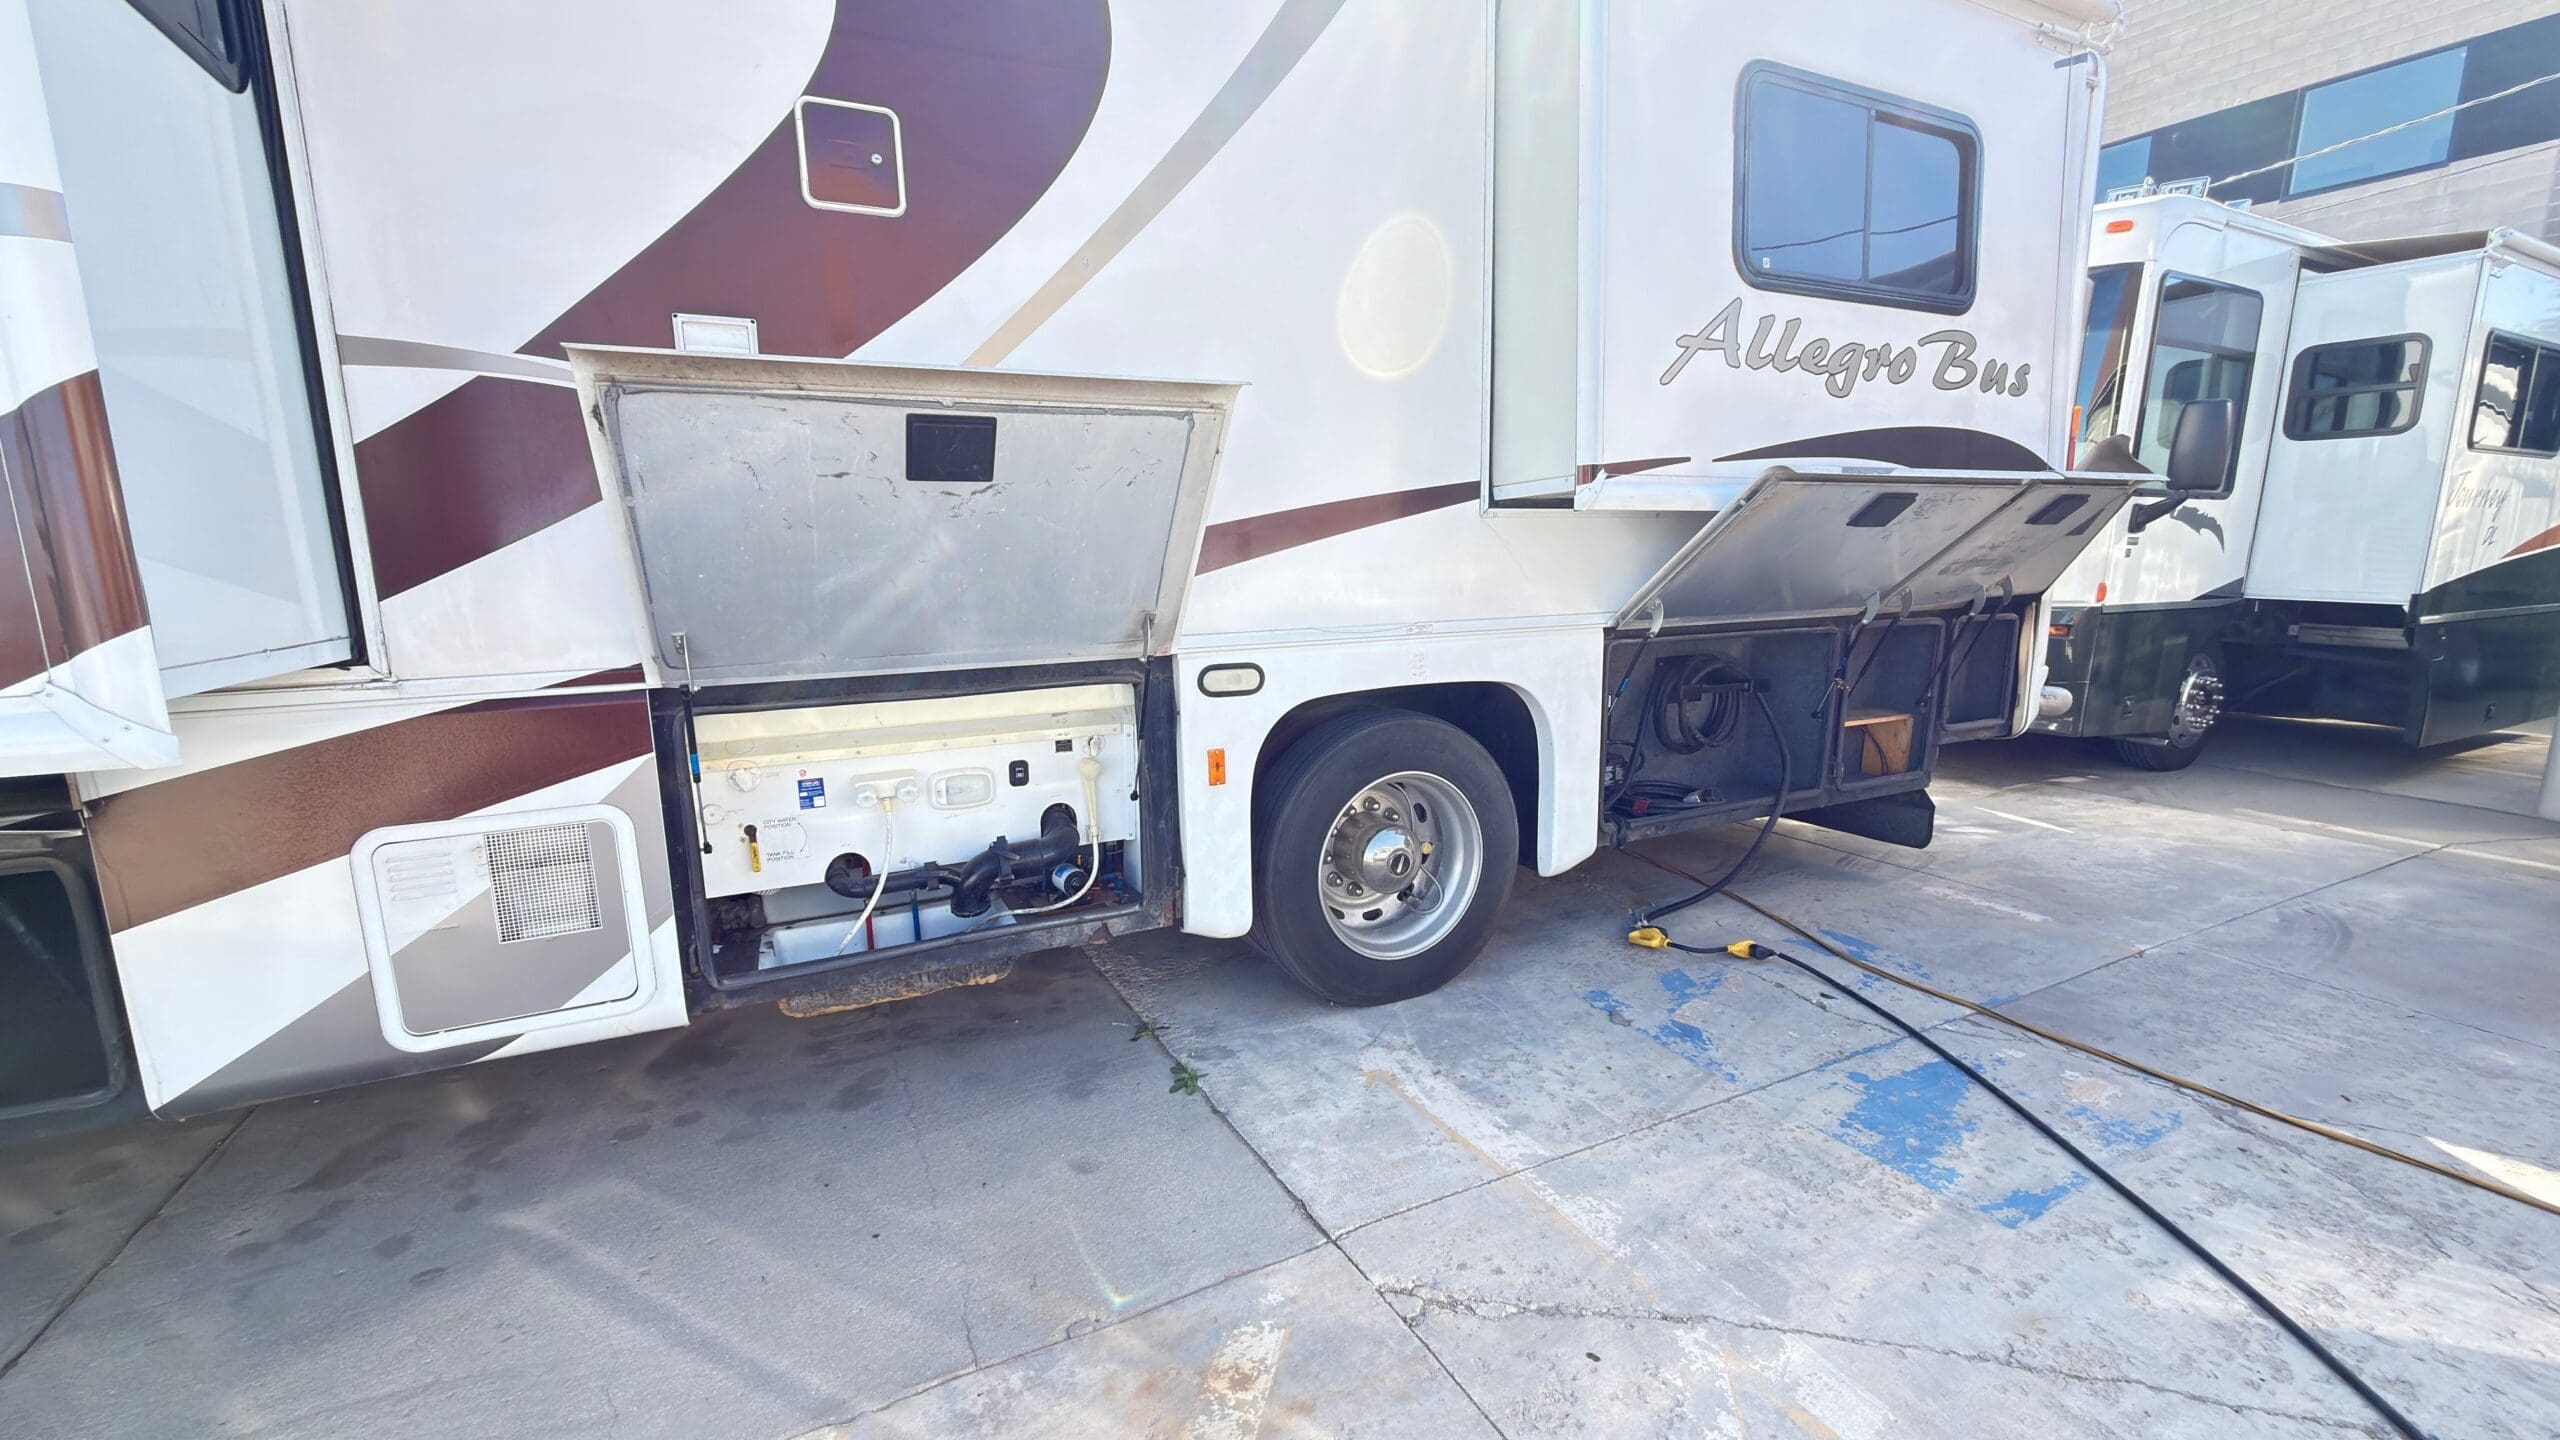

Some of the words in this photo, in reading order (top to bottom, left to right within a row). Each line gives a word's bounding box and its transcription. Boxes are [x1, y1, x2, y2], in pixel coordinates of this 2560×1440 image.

[1660, 297, 1917, 398] Allegro
[1918, 329, 2031, 397] Bus
[2446, 470, 2509, 522] Journey
[763, 822, 792, 830] POSITION
